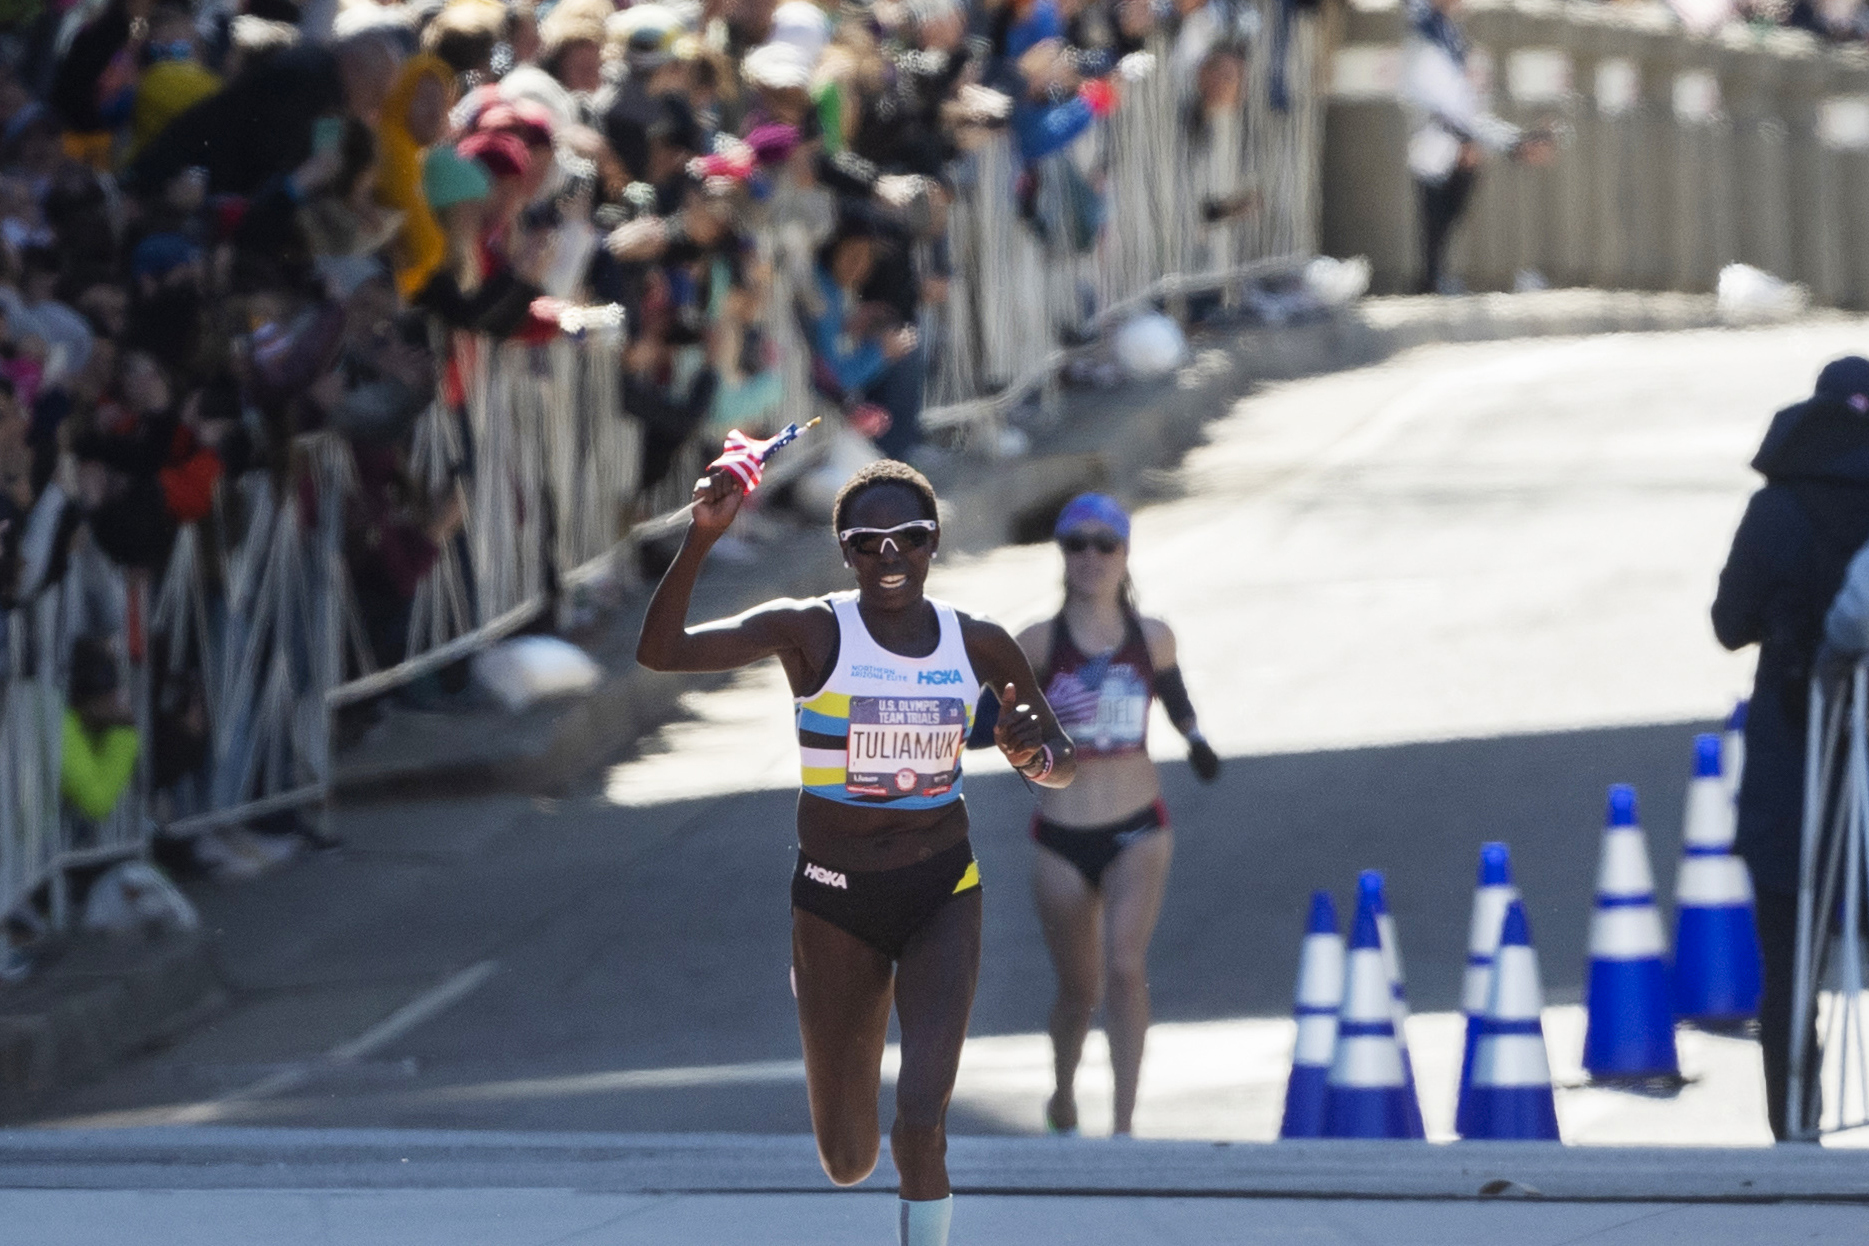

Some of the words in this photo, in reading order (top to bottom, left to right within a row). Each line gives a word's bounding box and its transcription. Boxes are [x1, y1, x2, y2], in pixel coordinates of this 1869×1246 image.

[851, 664, 895, 675] NORTHERN
[850, 671, 883, 680] ARIZONA
[886, 674, 908, 682] ELITE
[917, 669, 963, 685] HOKA
[878, 699, 897, 711] U.S.
[898, 700, 940, 712] OLYMPIC
[878, 712, 905, 724] TEAM
[906, 712, 941, 724] TRIALS
[853, 730, 958, 760] TULIAMUK
[804, 862, 847, 889] HOKA
